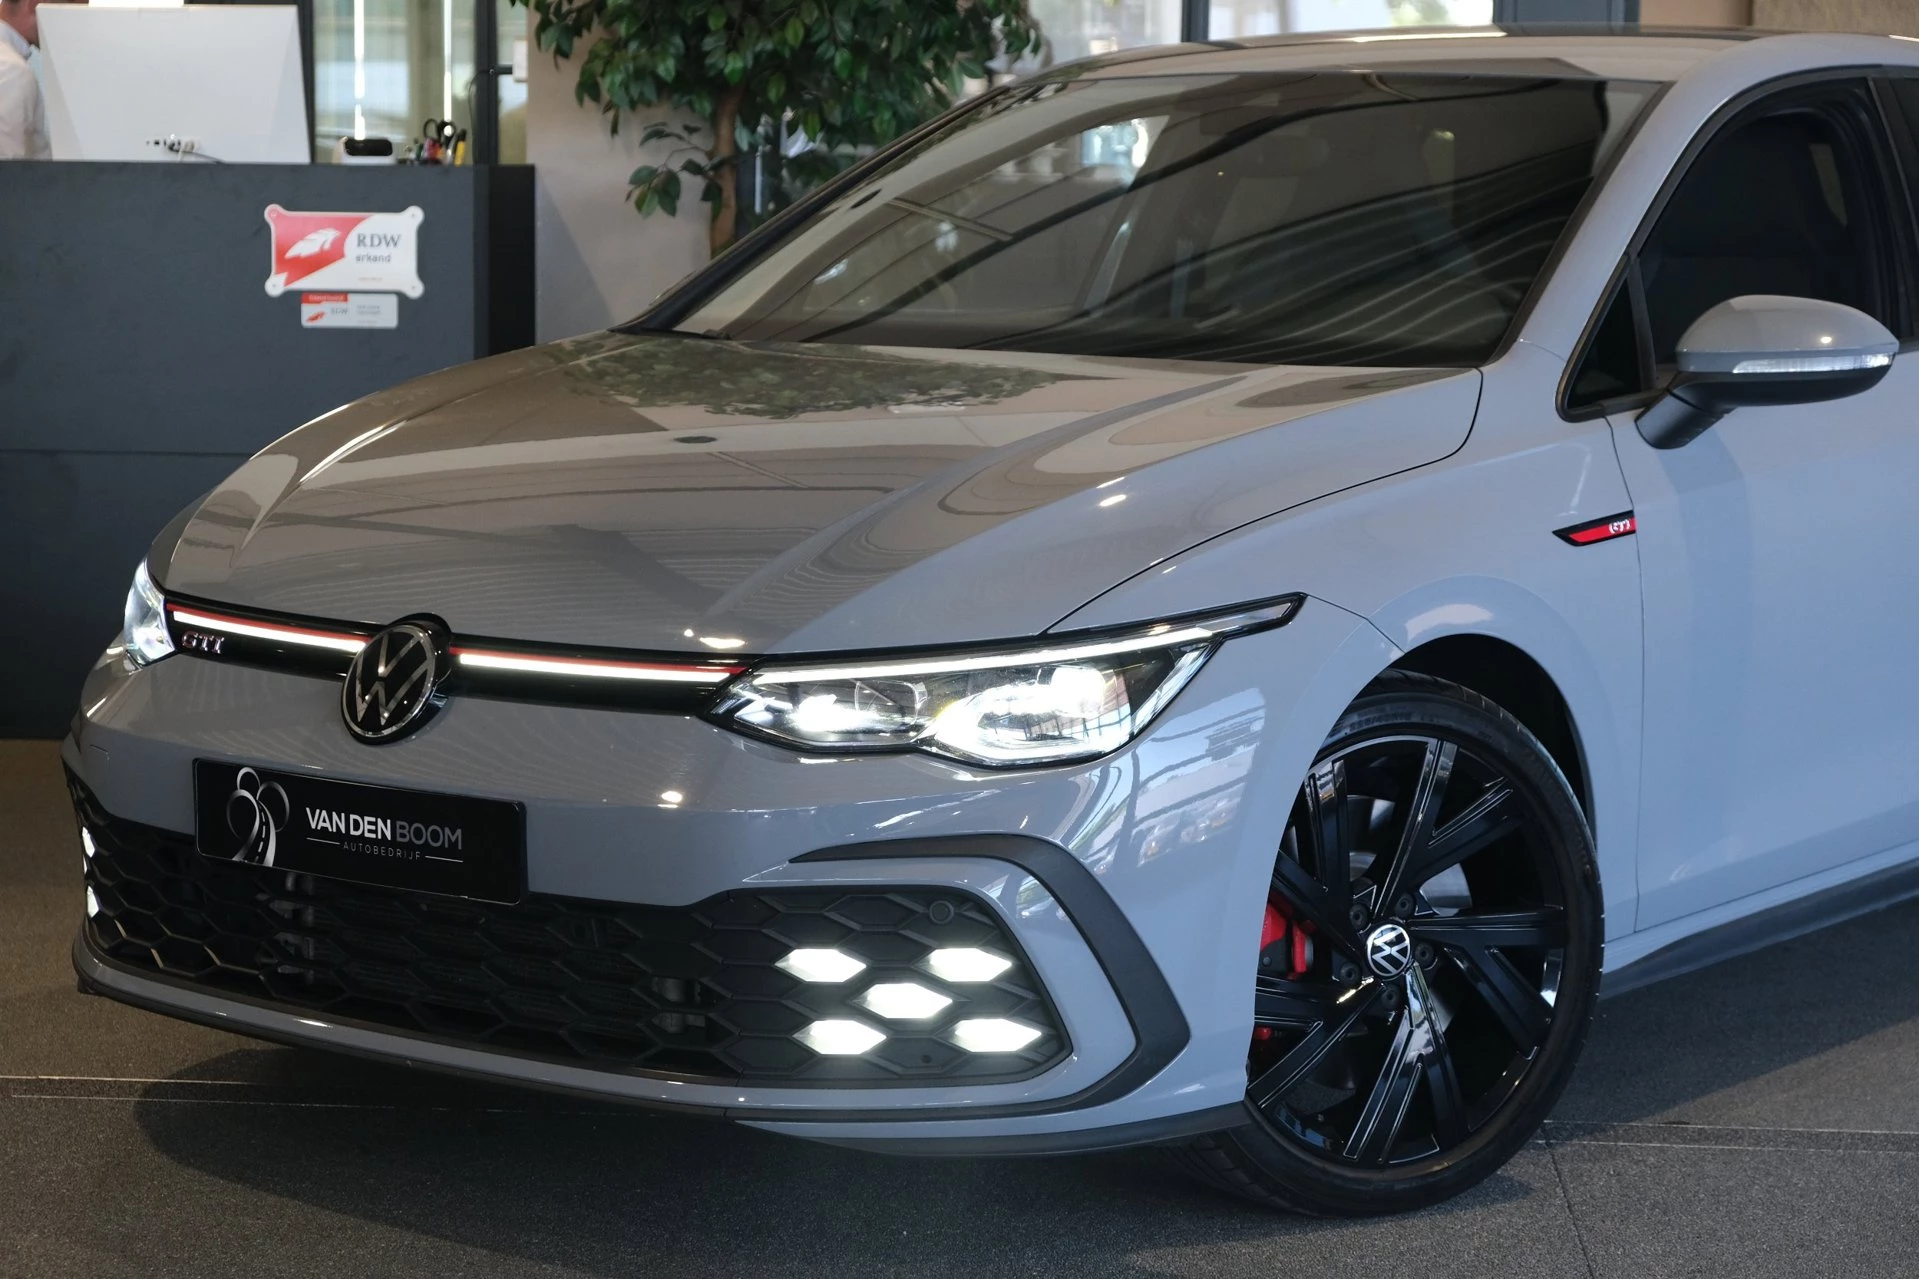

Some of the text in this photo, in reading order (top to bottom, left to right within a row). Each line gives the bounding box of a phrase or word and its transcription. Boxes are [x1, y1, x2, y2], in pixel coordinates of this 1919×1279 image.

[357, 233, 401, 248] RDW
[181, 630, 225, 654] GTI
[305, 807, 462, 850] VAN DEN BOOM
[343, 841, 421, 860] AUTOBEDRIJF
